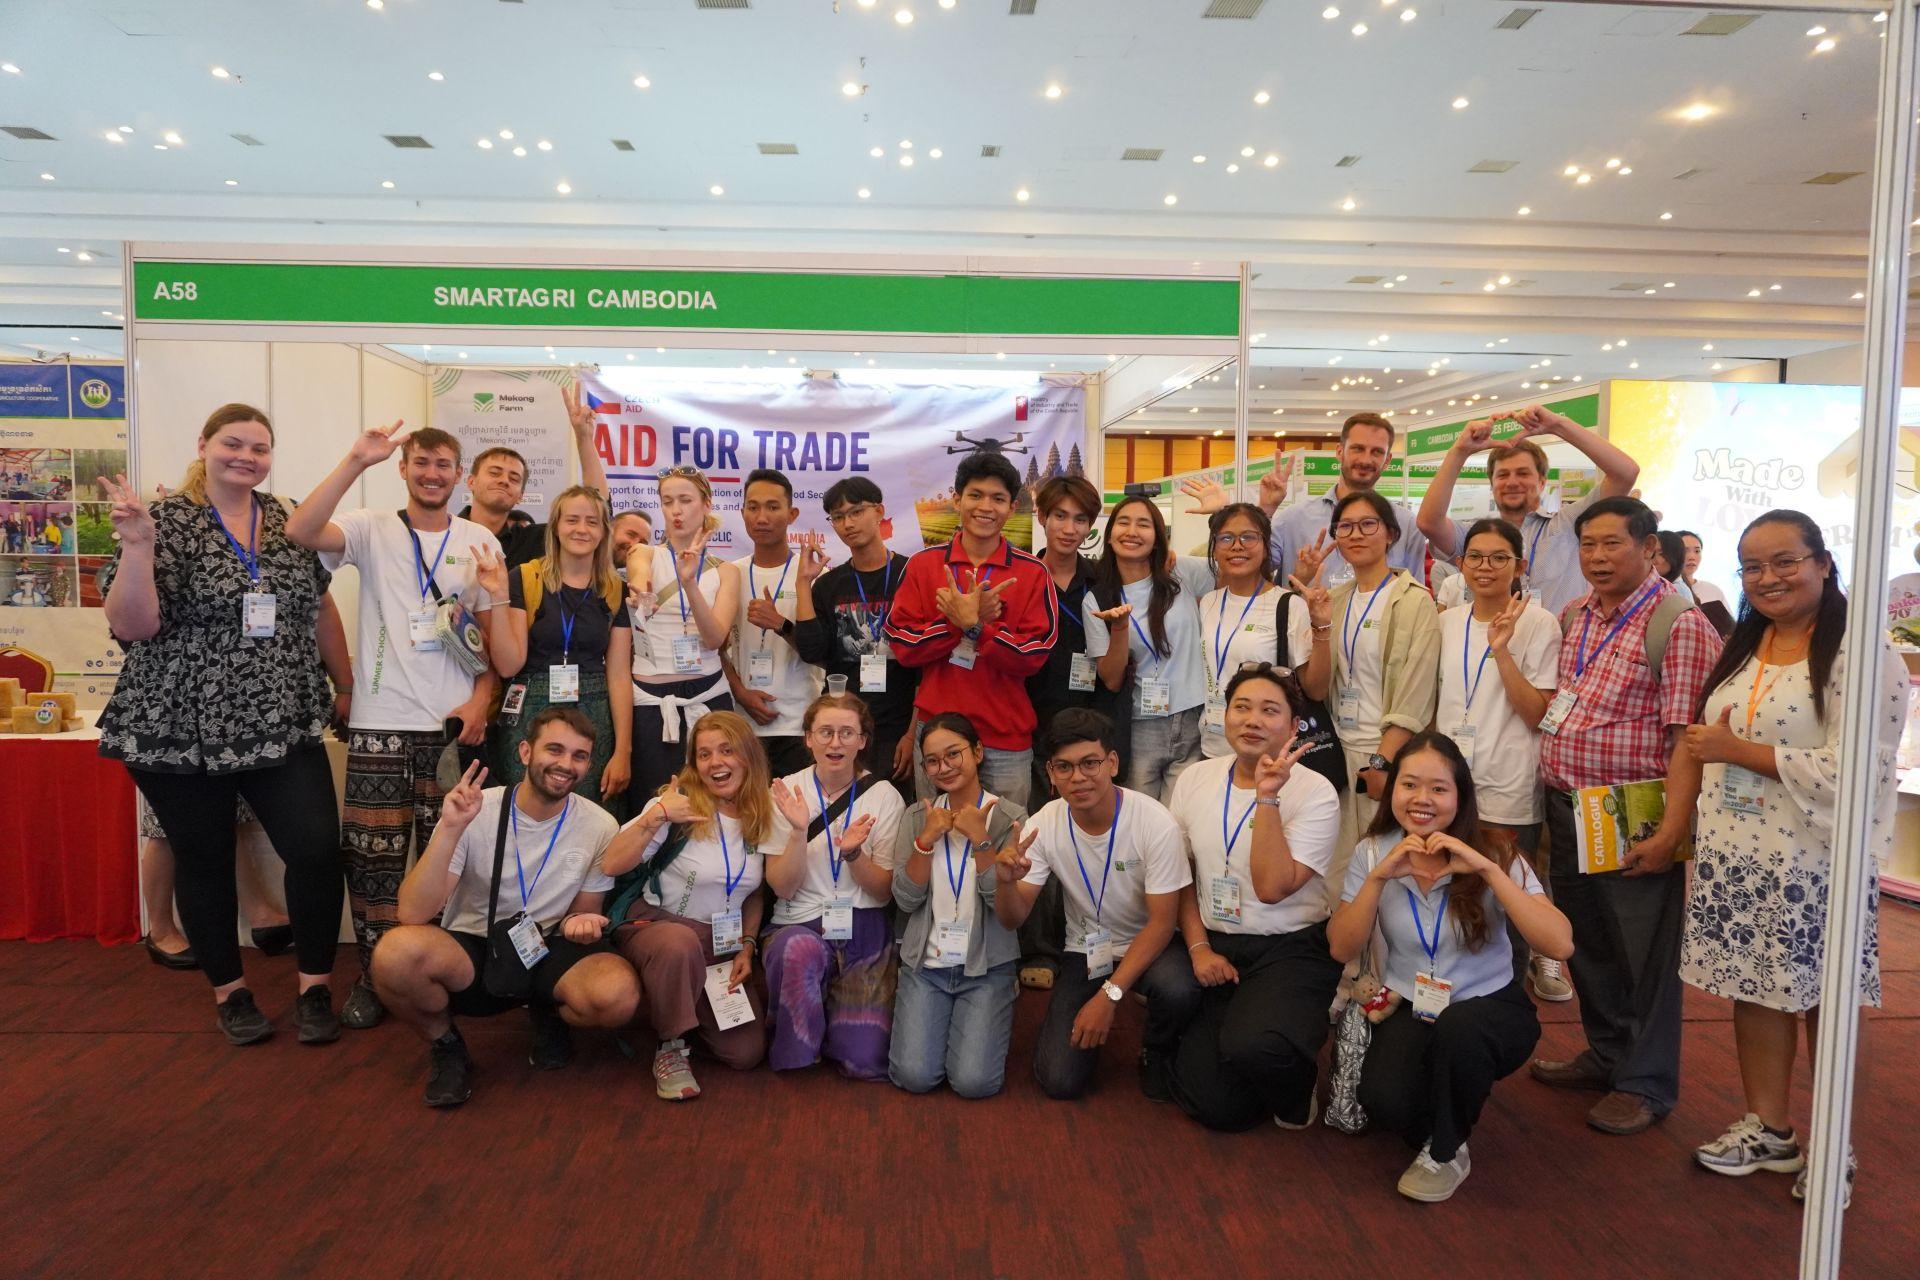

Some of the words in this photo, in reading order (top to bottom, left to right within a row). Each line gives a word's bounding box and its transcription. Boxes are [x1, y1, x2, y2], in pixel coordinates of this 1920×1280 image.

[153, 281, 198, 300] A58
[434, 287, 575, 308] SMARTAGRI
[587, 289, 717, 310] CAMBODIA
[499, 395, 534, 403] Mekong
[625, 405, 642, 413] AID
[594, 423, 657, 468] AID
[672, 425, 740, 470] FOR
[753, 430, 870, 472] TRADE
[1693, 448, 1804, 490] Made
[632, 486, 645, 495] for
[733, 489, 743, 497] of
[1726, 486, 1772, 507] With
[632, 500, 659, 509] Czech
[723, 503, 740, 511] and
[376, 625, 386, 659] SCHOOL
[371, 660, 383, 695] SUMMER
[1588, 794, 1605, 866] CATALOGUE
[685, 870, 697, 891] 2026
